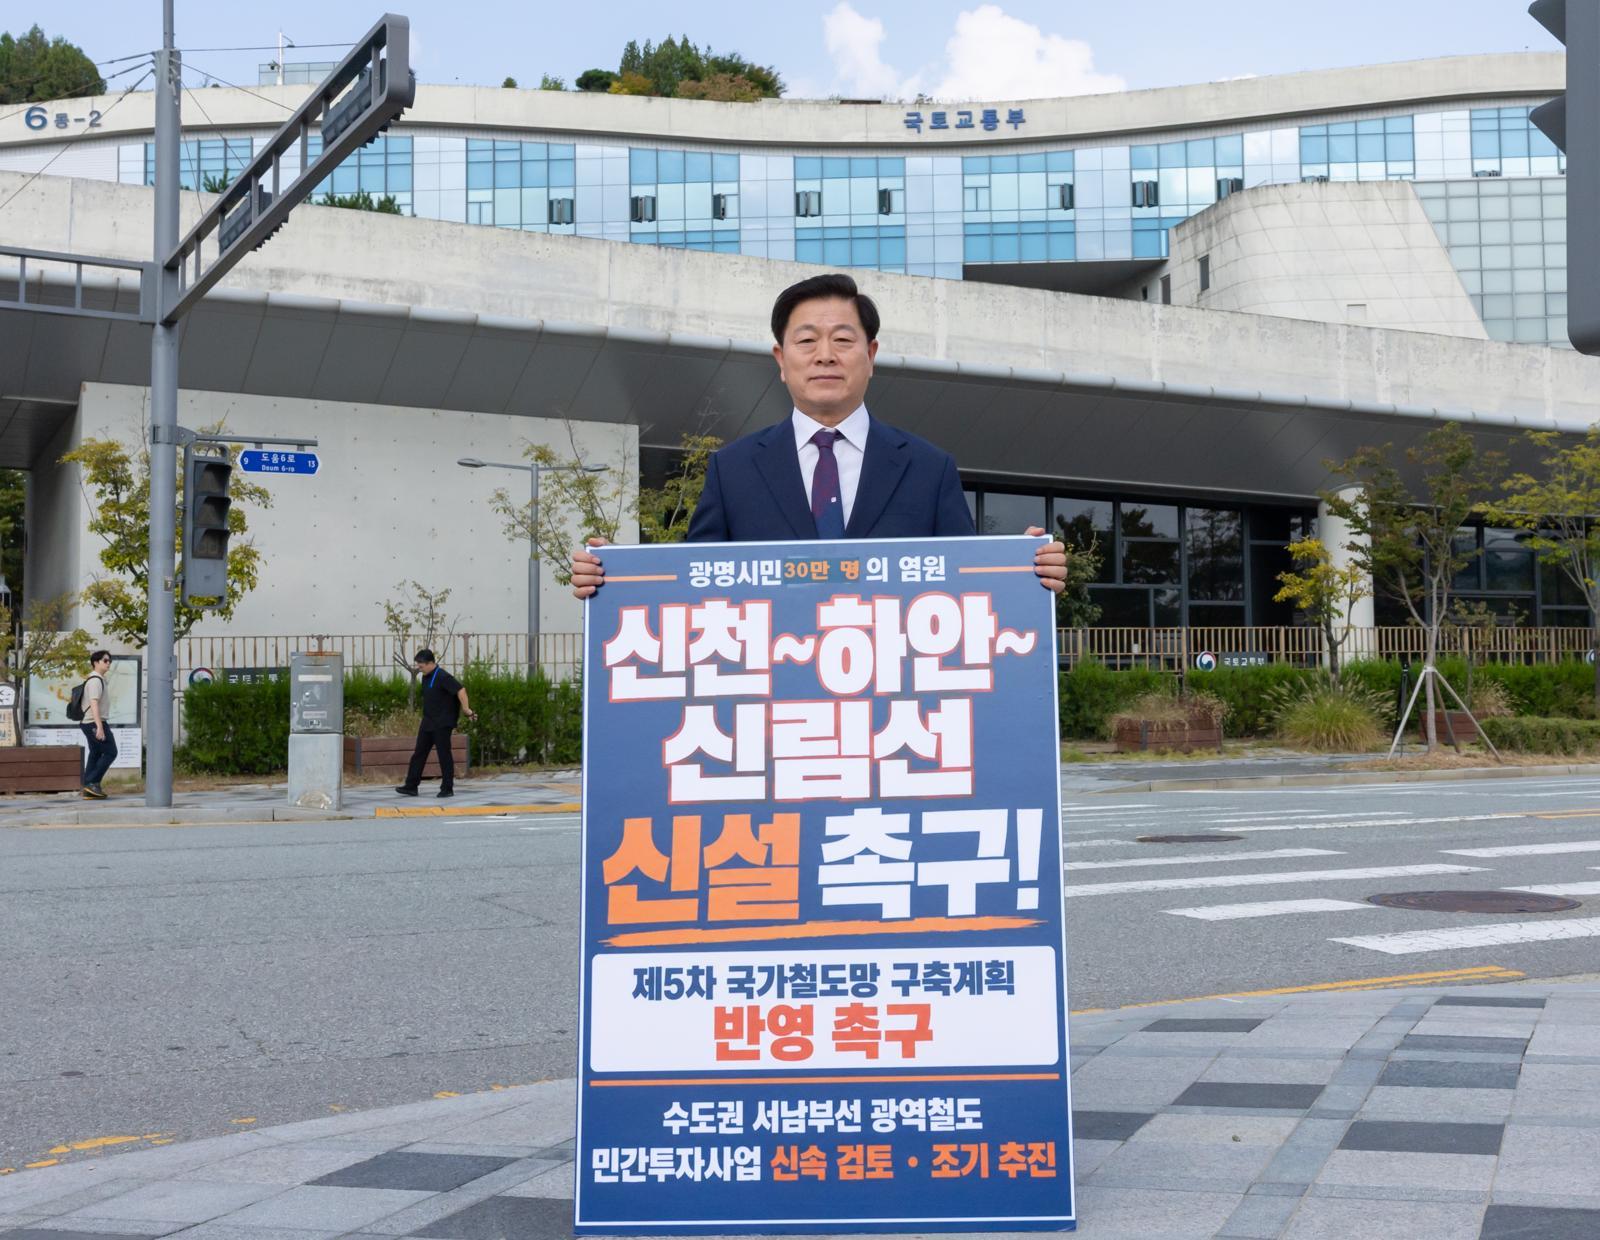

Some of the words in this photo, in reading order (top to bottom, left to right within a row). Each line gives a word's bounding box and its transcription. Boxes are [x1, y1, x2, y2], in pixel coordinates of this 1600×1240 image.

[903, 108, 1026, 134] 국토교통부
[243, 457, 249, 465] 9
[261, 453, 296, 464] 도움6로
[308, 460, 316, 468] 13
[898, 555, 946, 583] 염원
[662, 698, 974, 804] 신림선
[603, 812, 800, 925] 신설
[817, 808, 1044, 919] 촉구!
[632, 965, 717, 1001] 제5차
[727, 963, 881, 1000] 국가철도망
[891, 960, 1015, 998] 구축계획
[714, 1004, 814, 1062] 반영
[832, 1002, 933, 1060] 촉구
[663, 1101, 744, 1135] 수도권
[752, 1099, 862, 1134] 서남부선
[870, 1097, 983, 1133] 광역철도
[592, 1146, 761, 1183] 민간투자사업
[770, 1144, 828, 1181] 신속
[836, 1144, 894, 1180] 검토
[931, 1142, 989, 1178] 조기
[998, 1142, 1057, 1178] 추진
